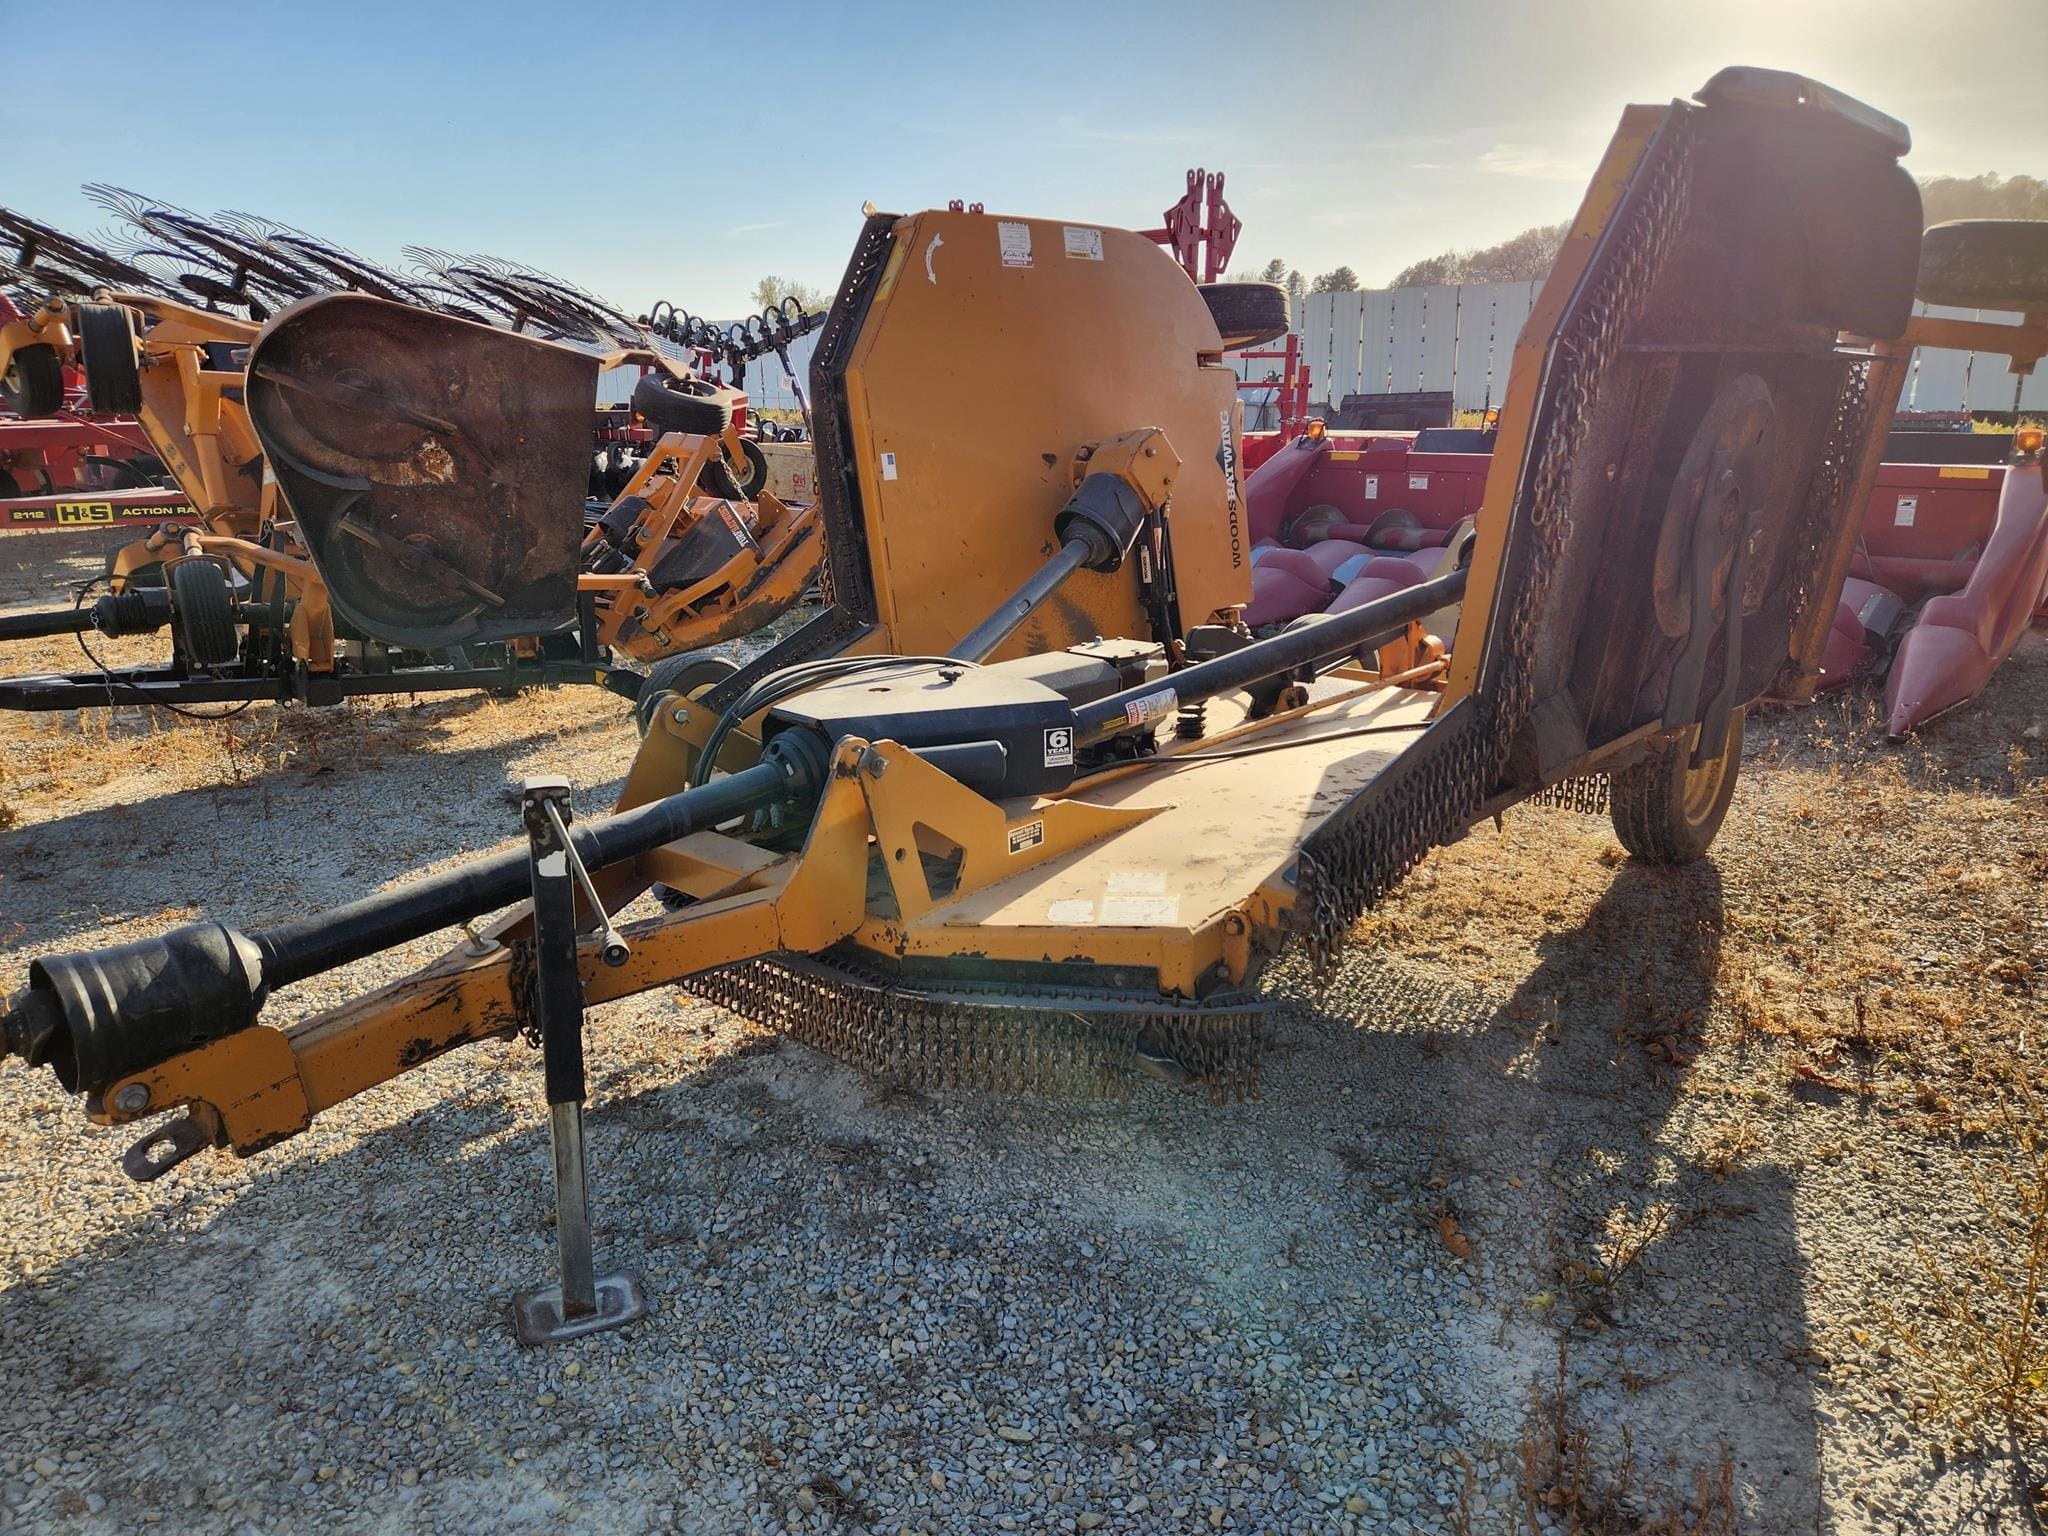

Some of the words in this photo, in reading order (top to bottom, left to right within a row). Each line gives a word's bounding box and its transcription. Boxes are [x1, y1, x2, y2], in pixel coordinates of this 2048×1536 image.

[13, 511, 46, 520] 2112
[60, 505, 109, 521] H&S
[122, 507, 173, 516] ACTION
[1049, 730, 1068, 748] 6
